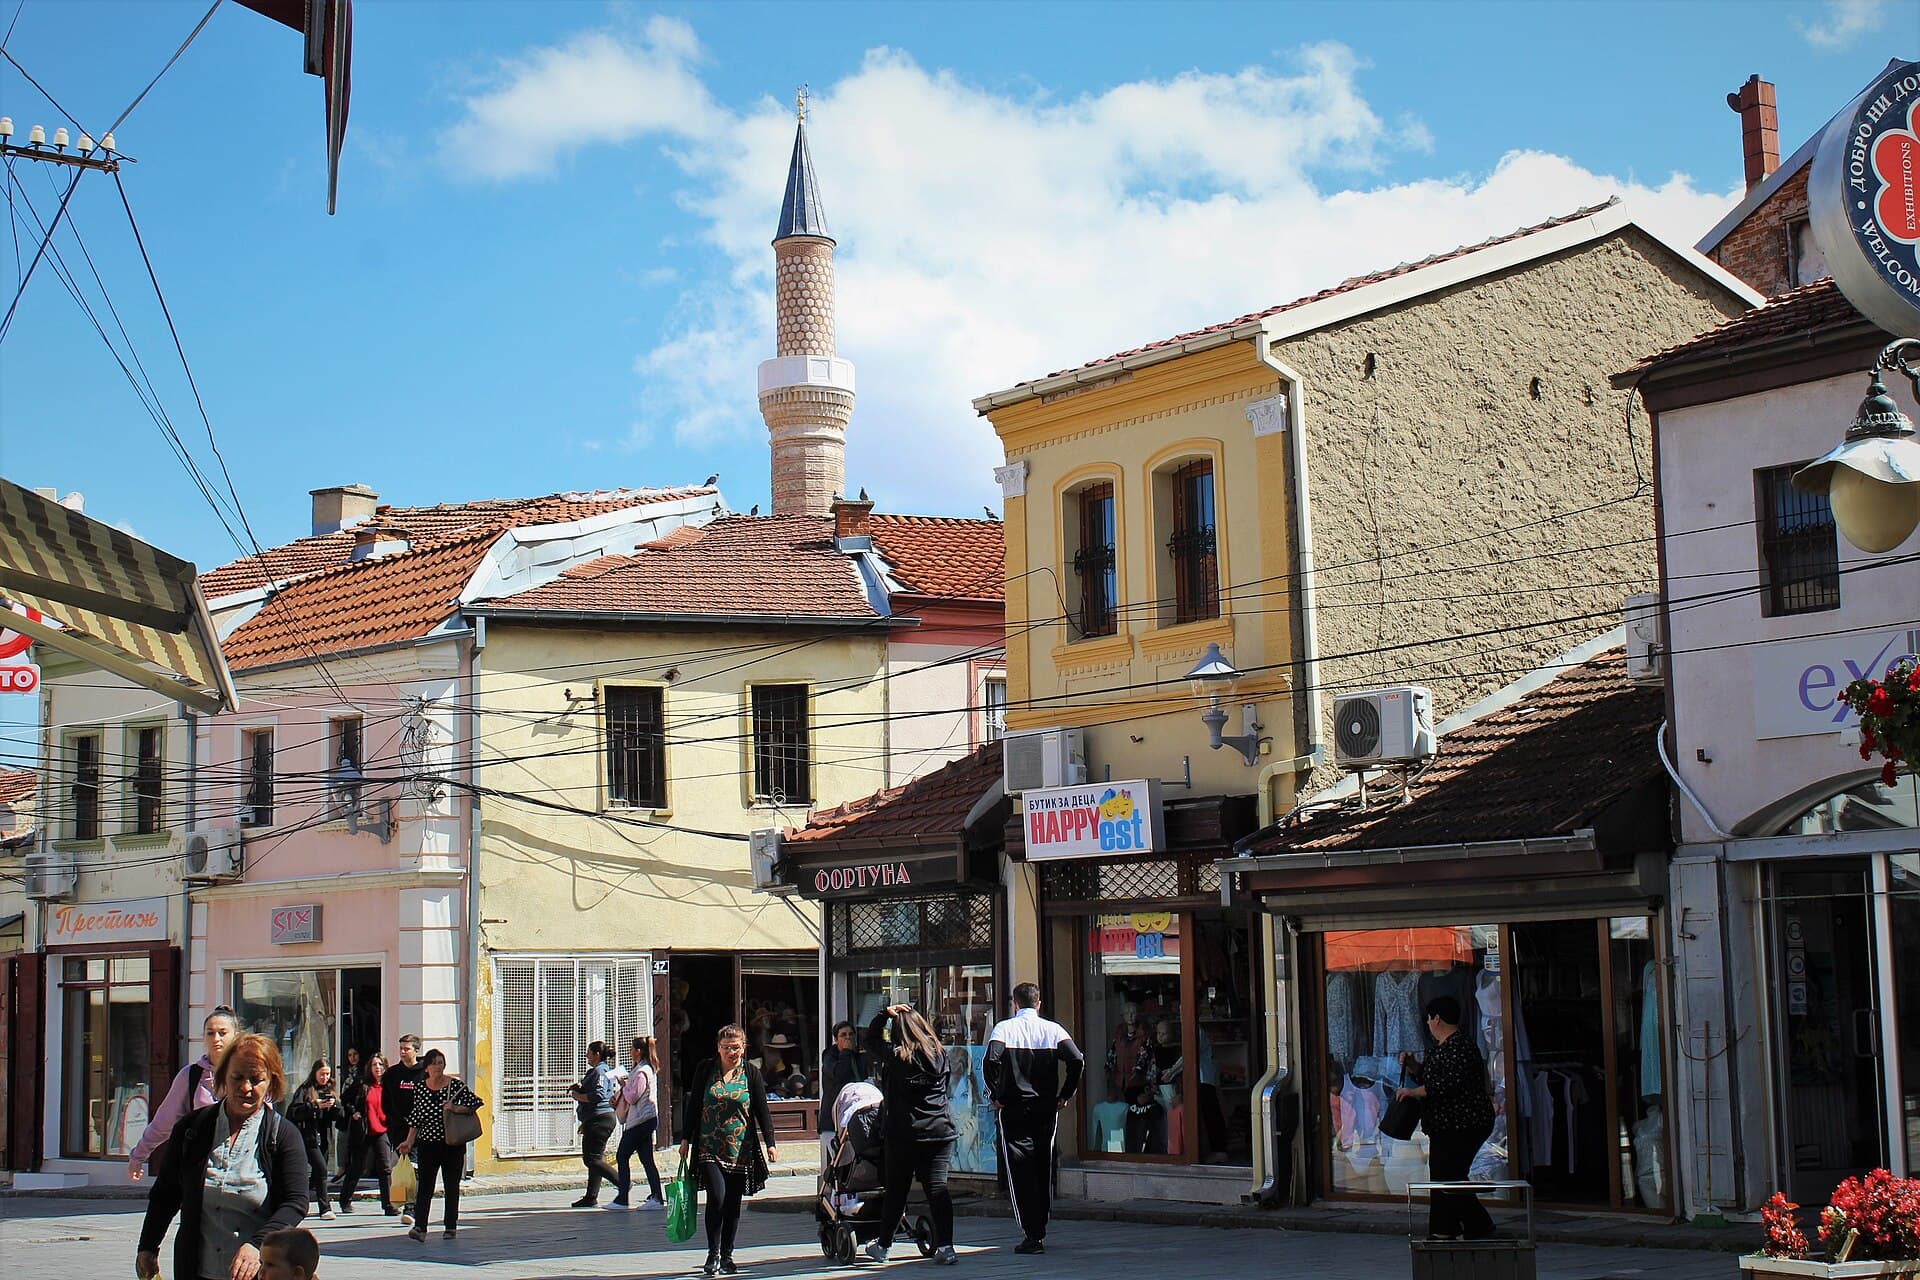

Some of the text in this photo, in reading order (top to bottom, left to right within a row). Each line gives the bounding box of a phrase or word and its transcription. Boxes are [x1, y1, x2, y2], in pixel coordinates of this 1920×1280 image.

[1850, 72, 1920, 193] ДОБРО НИ ДО
[1901, 142, 1917, 232] EXHIBITIONS
[1029, 793, 1096, 811] БУТИК ЗА ДЕЦА
[1030, 807, 1145, 851] HAPPY est
[815, 862, 911, 892] ФОРТУНА
[56, 906, 159, 939] Престиж
[273, 909, 311, 939] SIX
[653, 960, 666, 970] 47
